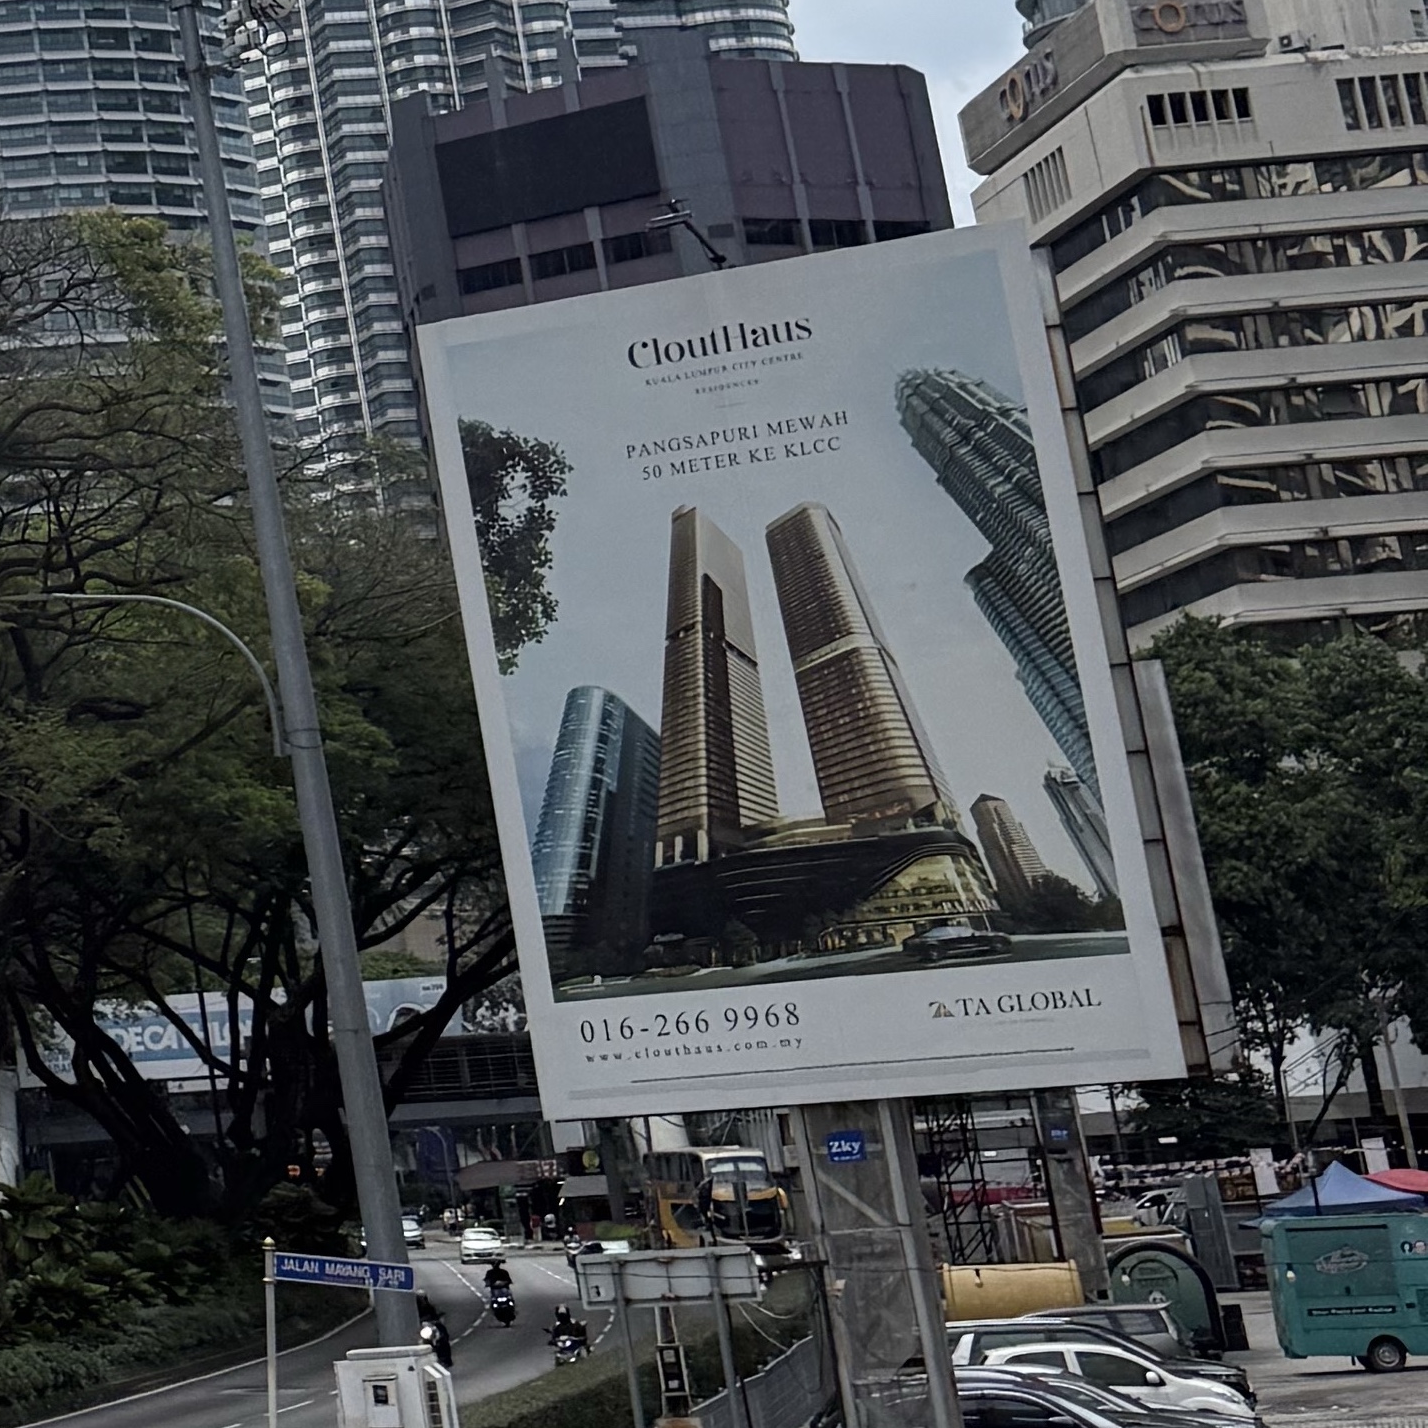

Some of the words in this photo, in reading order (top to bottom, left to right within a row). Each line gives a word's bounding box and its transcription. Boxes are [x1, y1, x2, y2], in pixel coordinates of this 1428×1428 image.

[627, 318, 813, 369] CloutHaus
[645, 372, 682, 387] KUALA
[683, 365, 728, 380] LUMPUR
[732, 359, 758, 371] CITY
[761, 351, 804, 366] CENTRE
[626, 424, 759, 459] PANGSAPURI
[766, 410, 849, 438] MEWAH
[642, 464, 663, 481] 50
[670, 452, 741, 477] METER
[748, 446, 777, 464] KE
[784, 435, 842, 460] KLCC
[955, 996, 992, 1017] TA
[996, 987, 1102, 1014] GLOBAL
[580, 1009, 710, 1043] 016-266
[724, 1002, 800, 1032] 9968
[585, 1036, 803, 1063] www.clouthaus.com.my
[281, 1258, 320, 1274] JALAN
[378, 1267, 405, 1283] SARI
